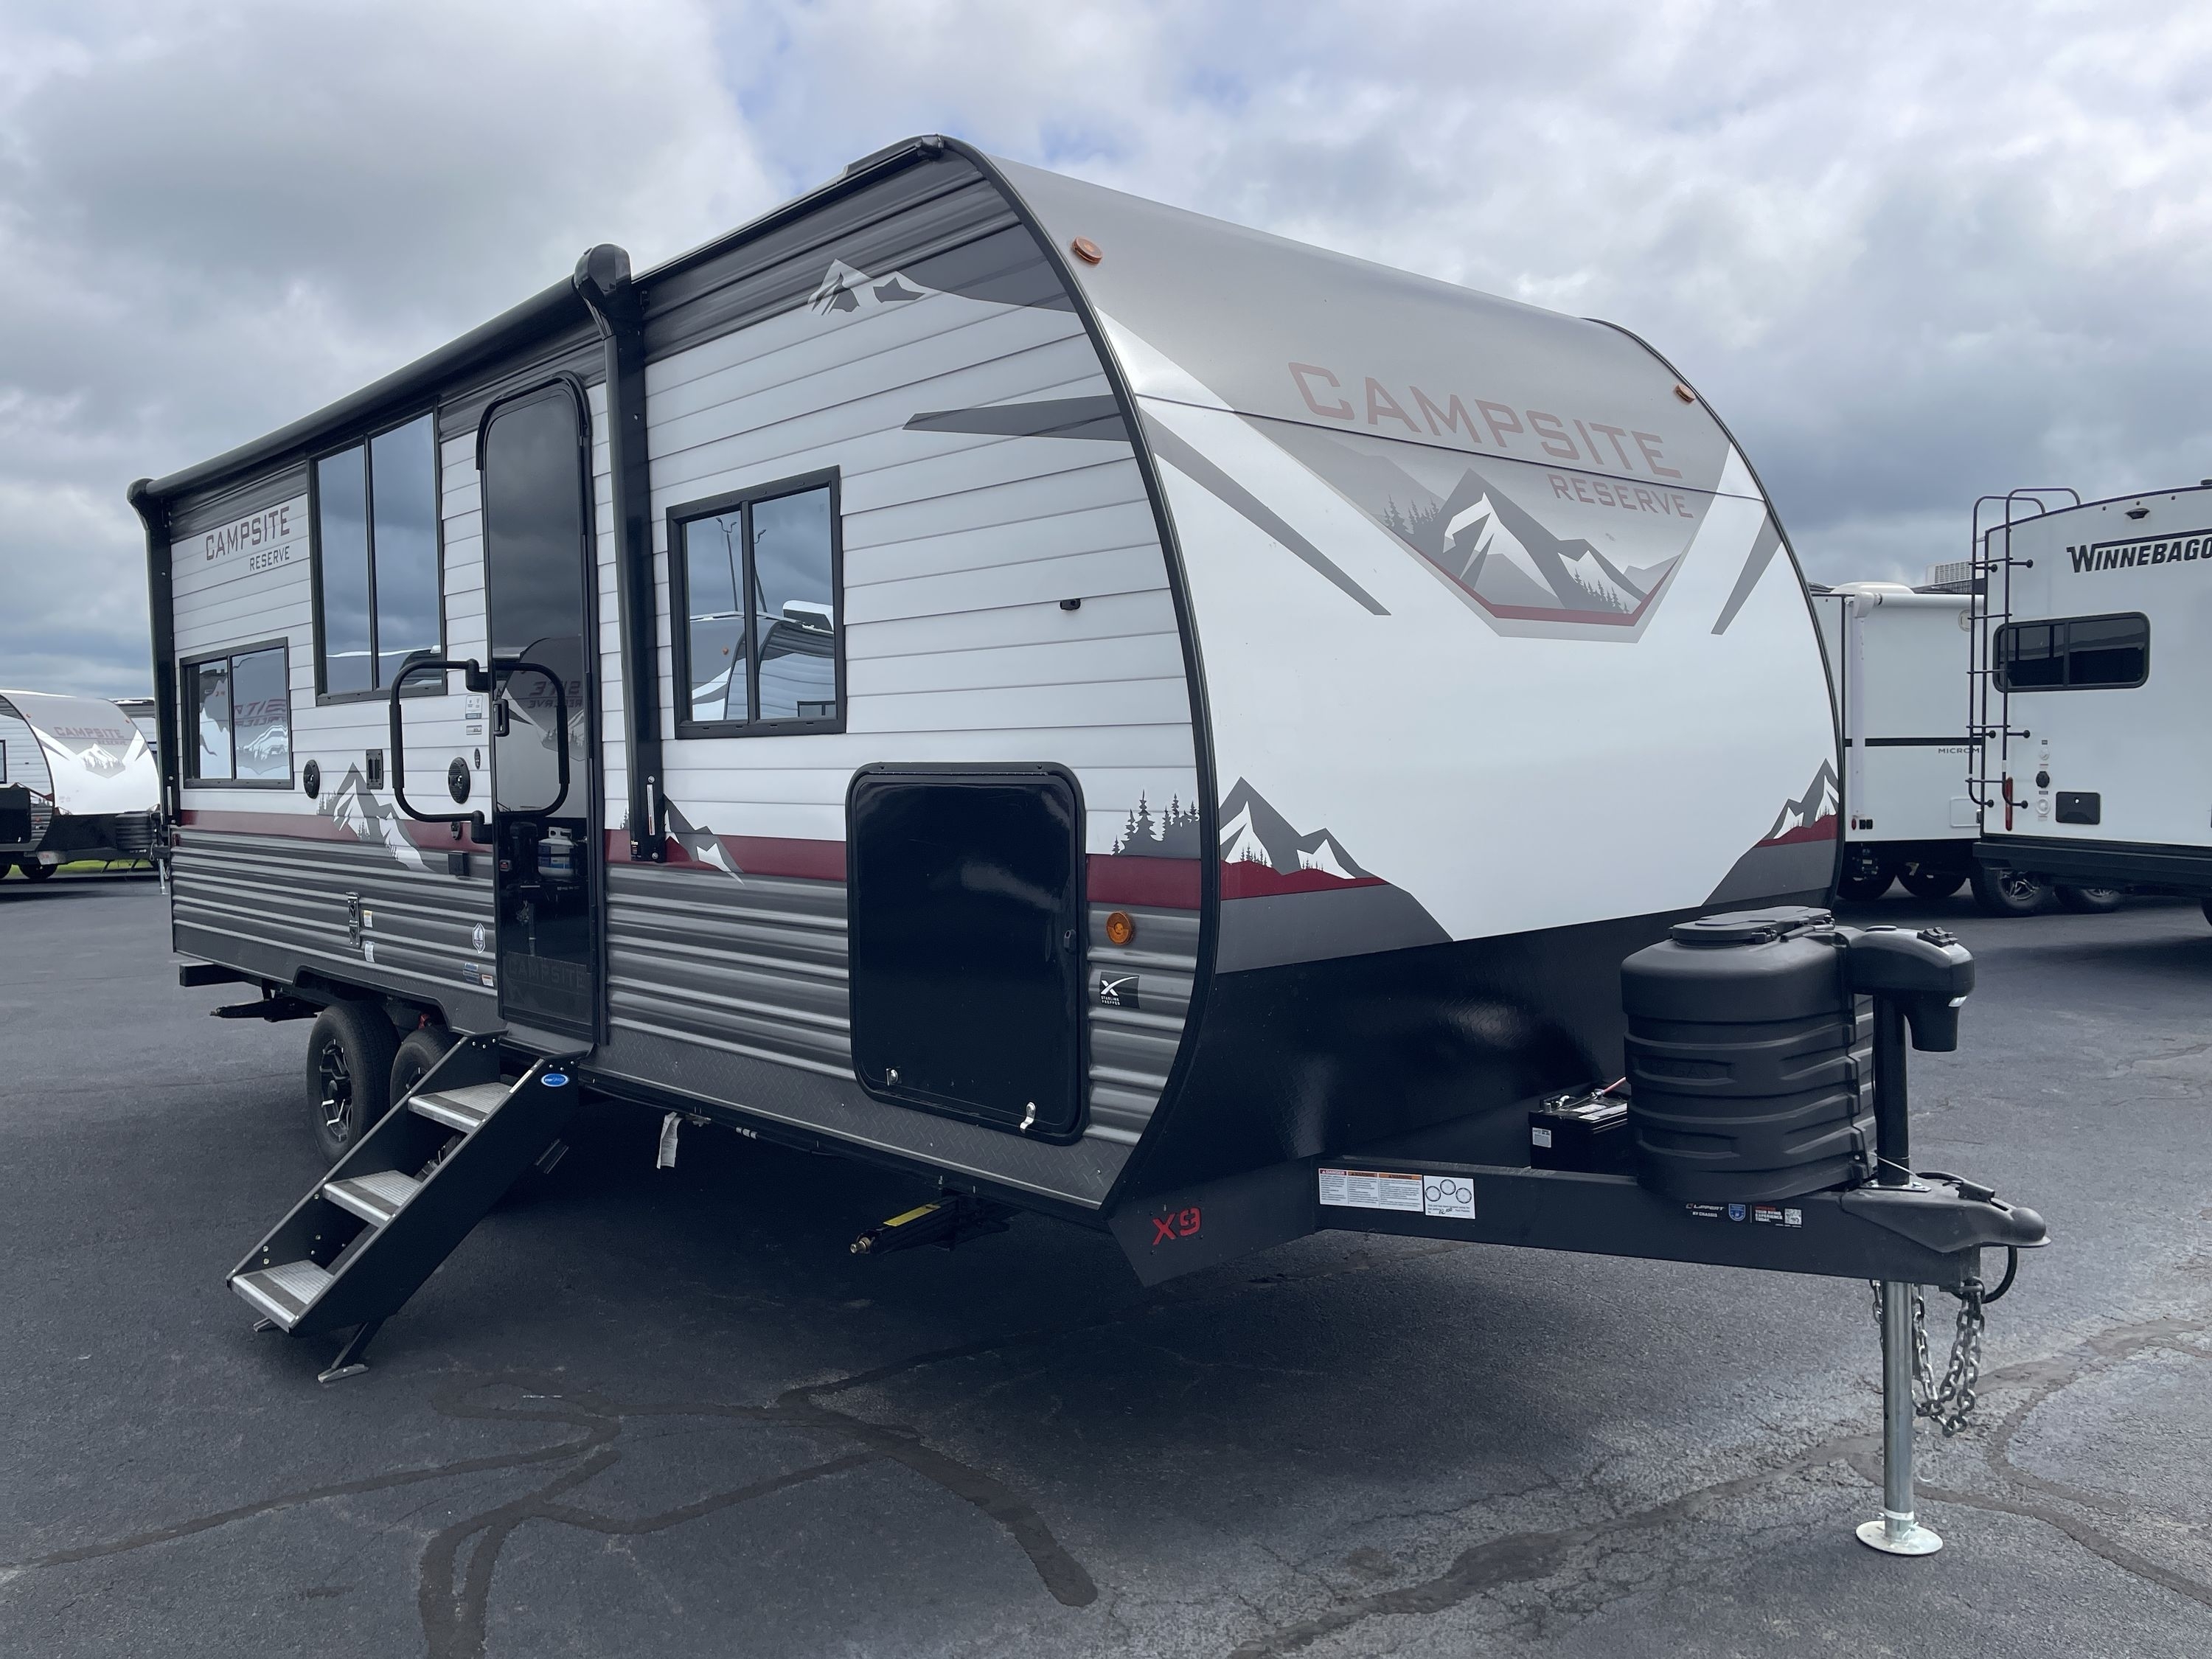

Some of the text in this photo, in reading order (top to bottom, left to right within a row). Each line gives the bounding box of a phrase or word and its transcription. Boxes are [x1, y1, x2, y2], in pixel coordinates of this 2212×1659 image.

[1288, 361, 1683, 479] CAMPSITE
[1547, 473, 1694, 518] RESERVE
[206, 506, 290, 561] CAMPSITE
[249, 546, 290, 571] RESERVE
[2066, 536, 2212, 573] WINNEBAGO
[53, 726, 125, 739] CAMPSITE
[1152, 1208, 1200, 1246] X9
